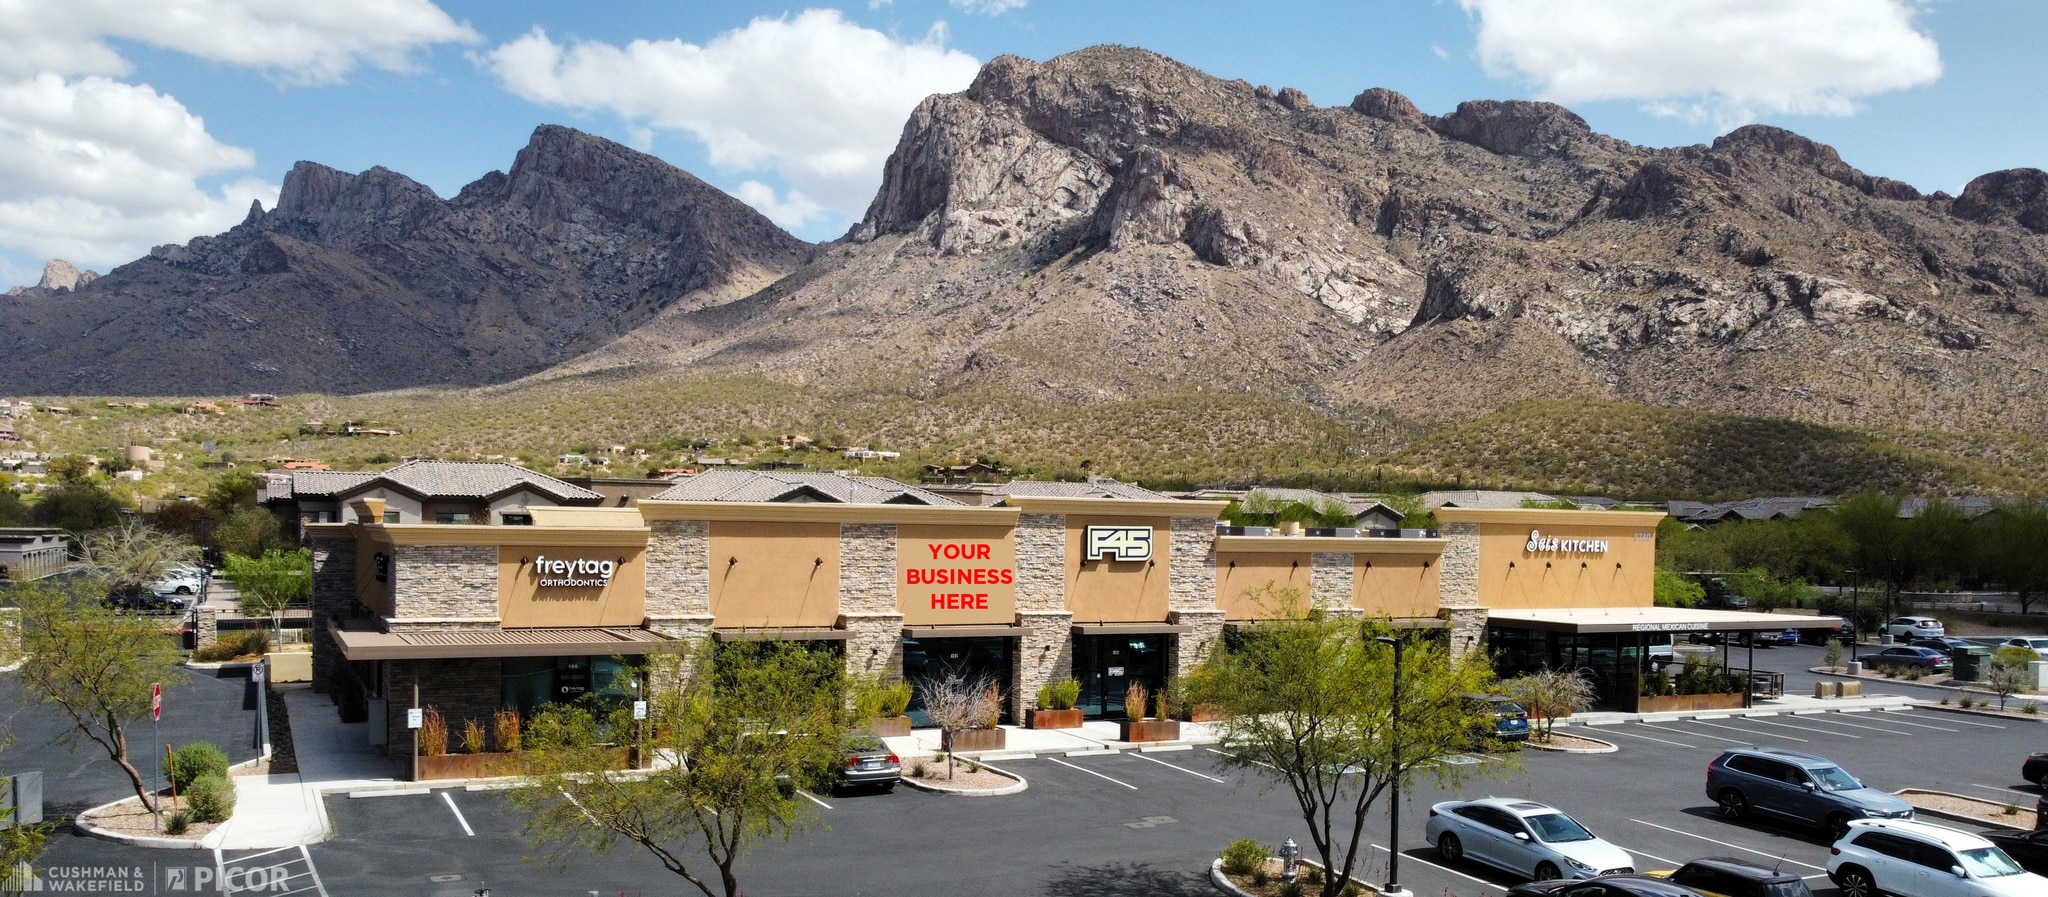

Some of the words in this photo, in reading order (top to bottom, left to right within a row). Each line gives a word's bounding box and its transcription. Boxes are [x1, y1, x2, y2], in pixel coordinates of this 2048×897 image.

[1090, 527, 1151, 559] F45
[1526, 529, 1559, 552] Seis
[1561, 539, 1609, 553] KITCHEN
[1633, 532, 1651, 541] 9740
[535, 555, 613, 579] freytag
[540, 579, 608, 587] ORTHODONTICS
[1632, 623, 1661, 632] REGIONAL
[1661, 623, 1687, 631] MEXICAN
[1687, 622, 1709, 630] CUISINE
